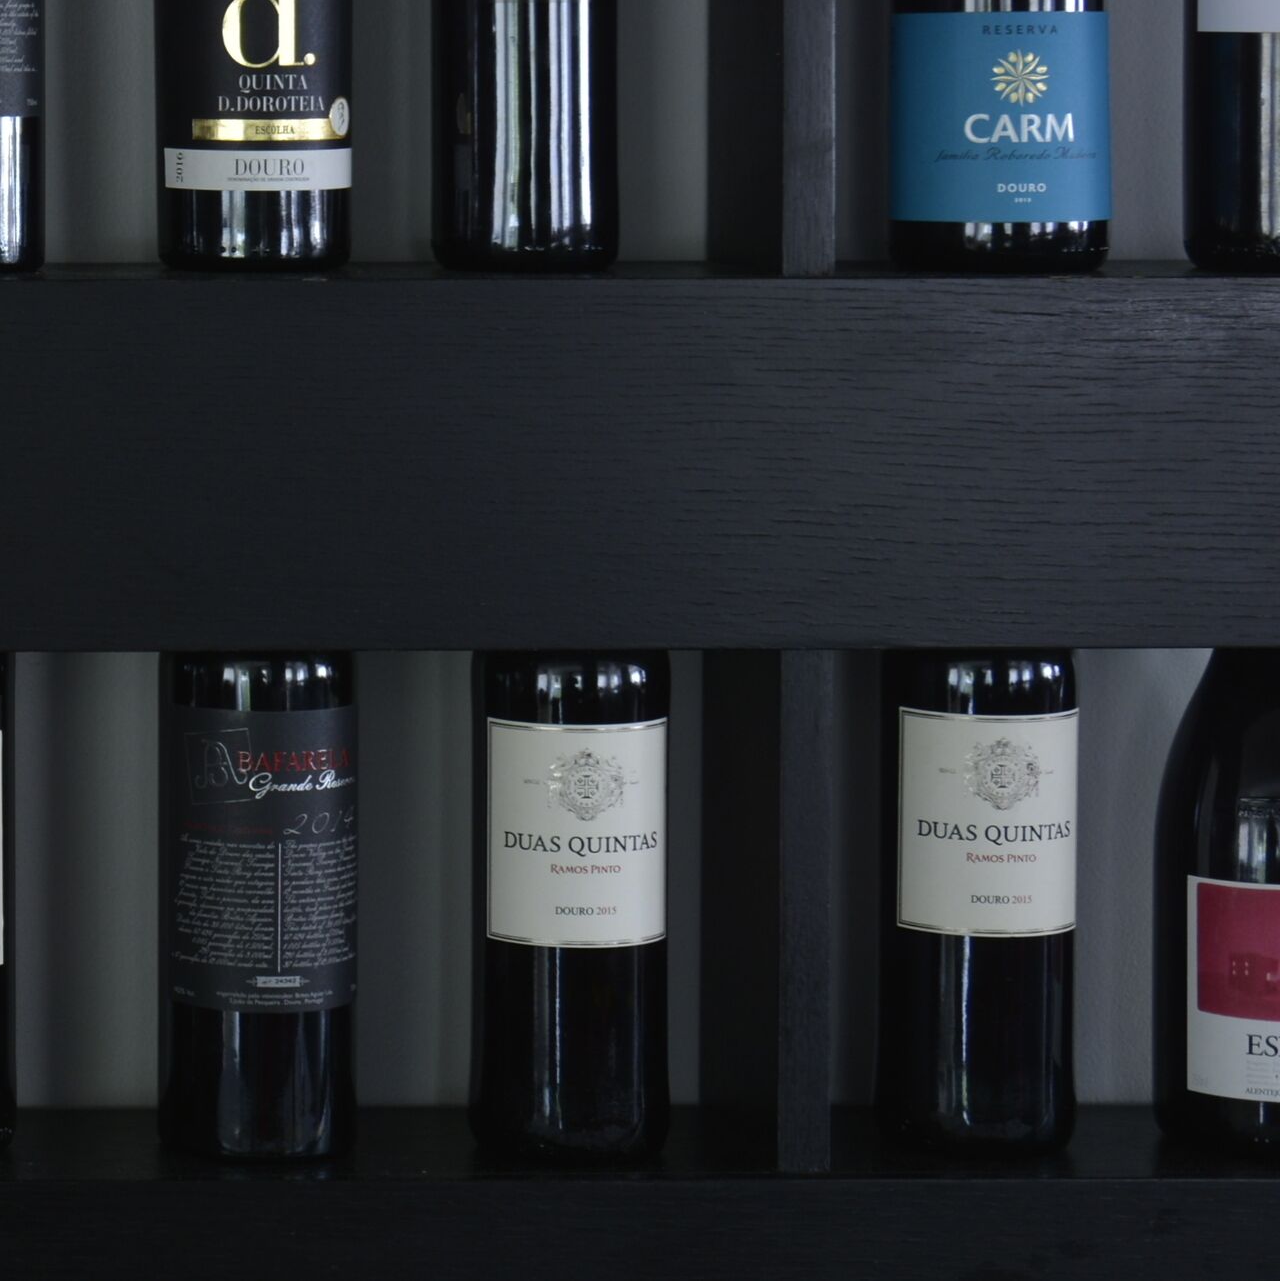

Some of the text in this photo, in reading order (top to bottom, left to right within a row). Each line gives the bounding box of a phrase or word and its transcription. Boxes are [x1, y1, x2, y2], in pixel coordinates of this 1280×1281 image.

[982, 24, 1058, 36] RESERVA
[238, 74, 309, 94] QUINTA
[218, 95, 326, 113] D.DOROTEIA
[254, 125, 295, 136] ESCOLHA
[964, 112, 1075, 144] CARM
[235, 158, 306, 177] DOURO
[996, 182, 1048, 194] DOURO
[248, 772, 314, 800] Grande
[917, 819, 1071, 846] DUAS QUINTAS
[503, 831, 658, 857] DUAS QUINTAS
[966, 852, 1037, 864] RAMOS PINTO
[550, 863, 621, 875] RAMOS PINTO
[970, 894, 1033, 905] DOURO 2015
[555, 905, 617, 916] DOURO 2015
